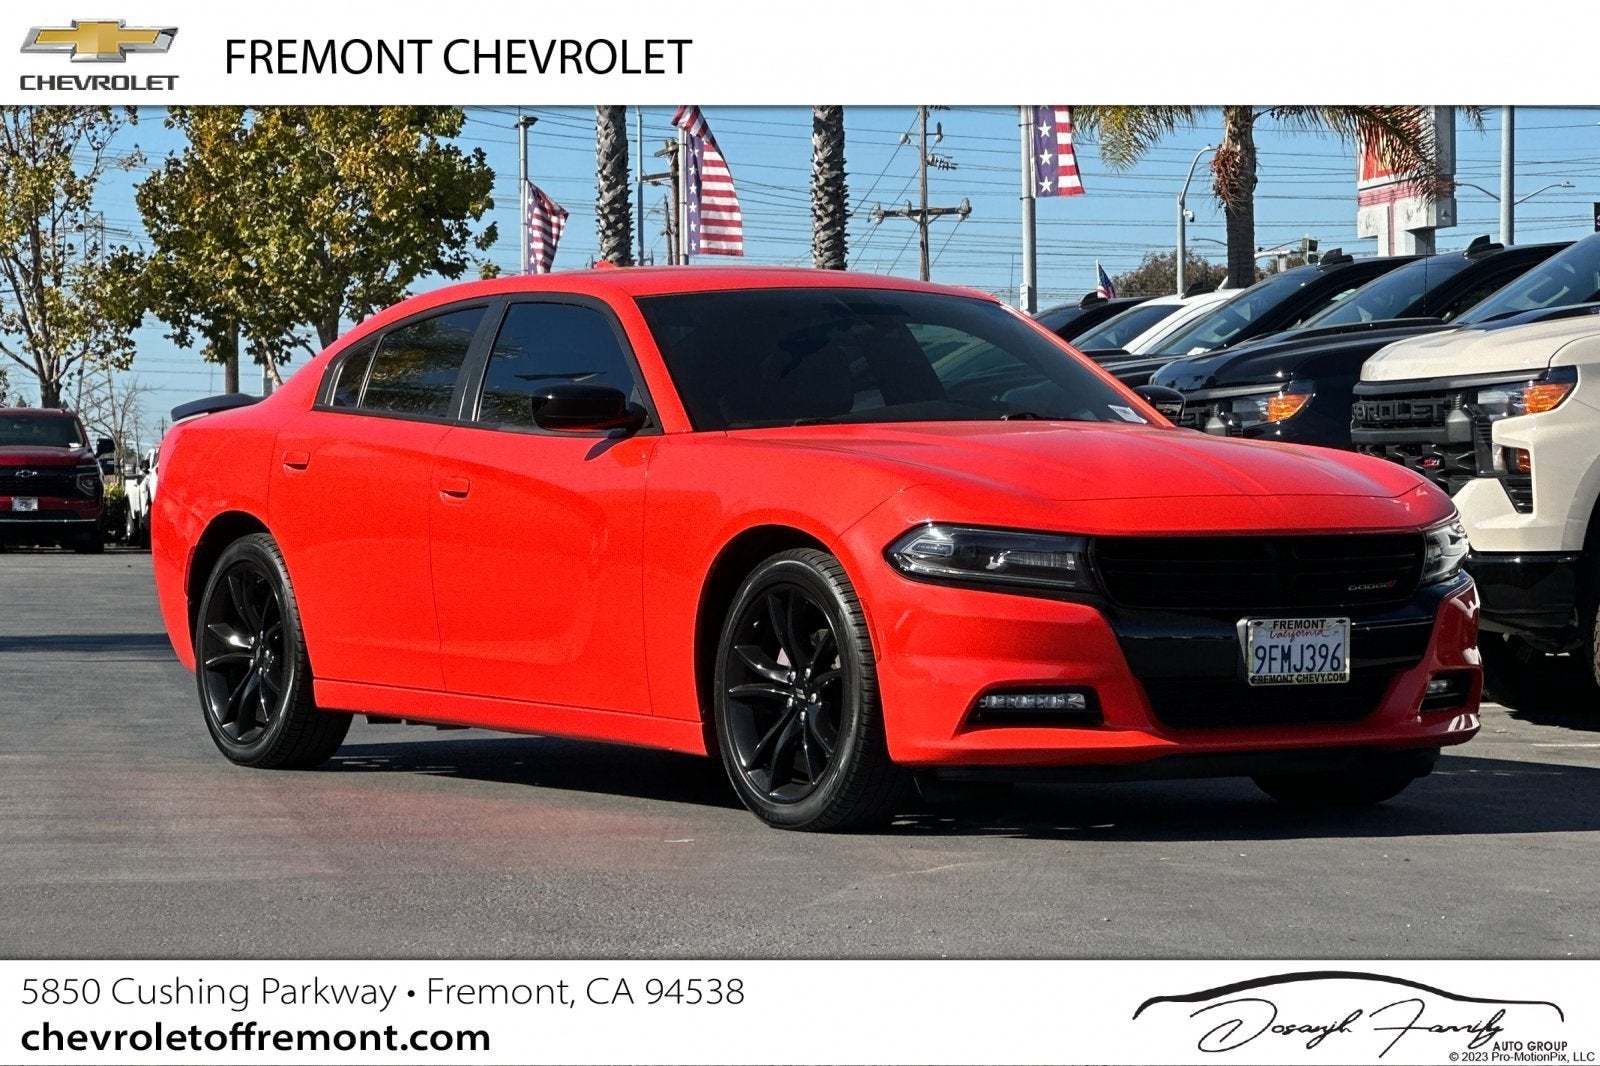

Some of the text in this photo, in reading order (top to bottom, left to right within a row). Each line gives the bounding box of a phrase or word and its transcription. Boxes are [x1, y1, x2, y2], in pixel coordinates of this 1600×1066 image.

[1273, 619, 1326, 630] FREMONT
[1270, 629, 1330, 643] California
[1254, 643, 1342, 674] 9FMJ396
[1252, 672, 1347, 684] FREMONT CHEVY.COM
